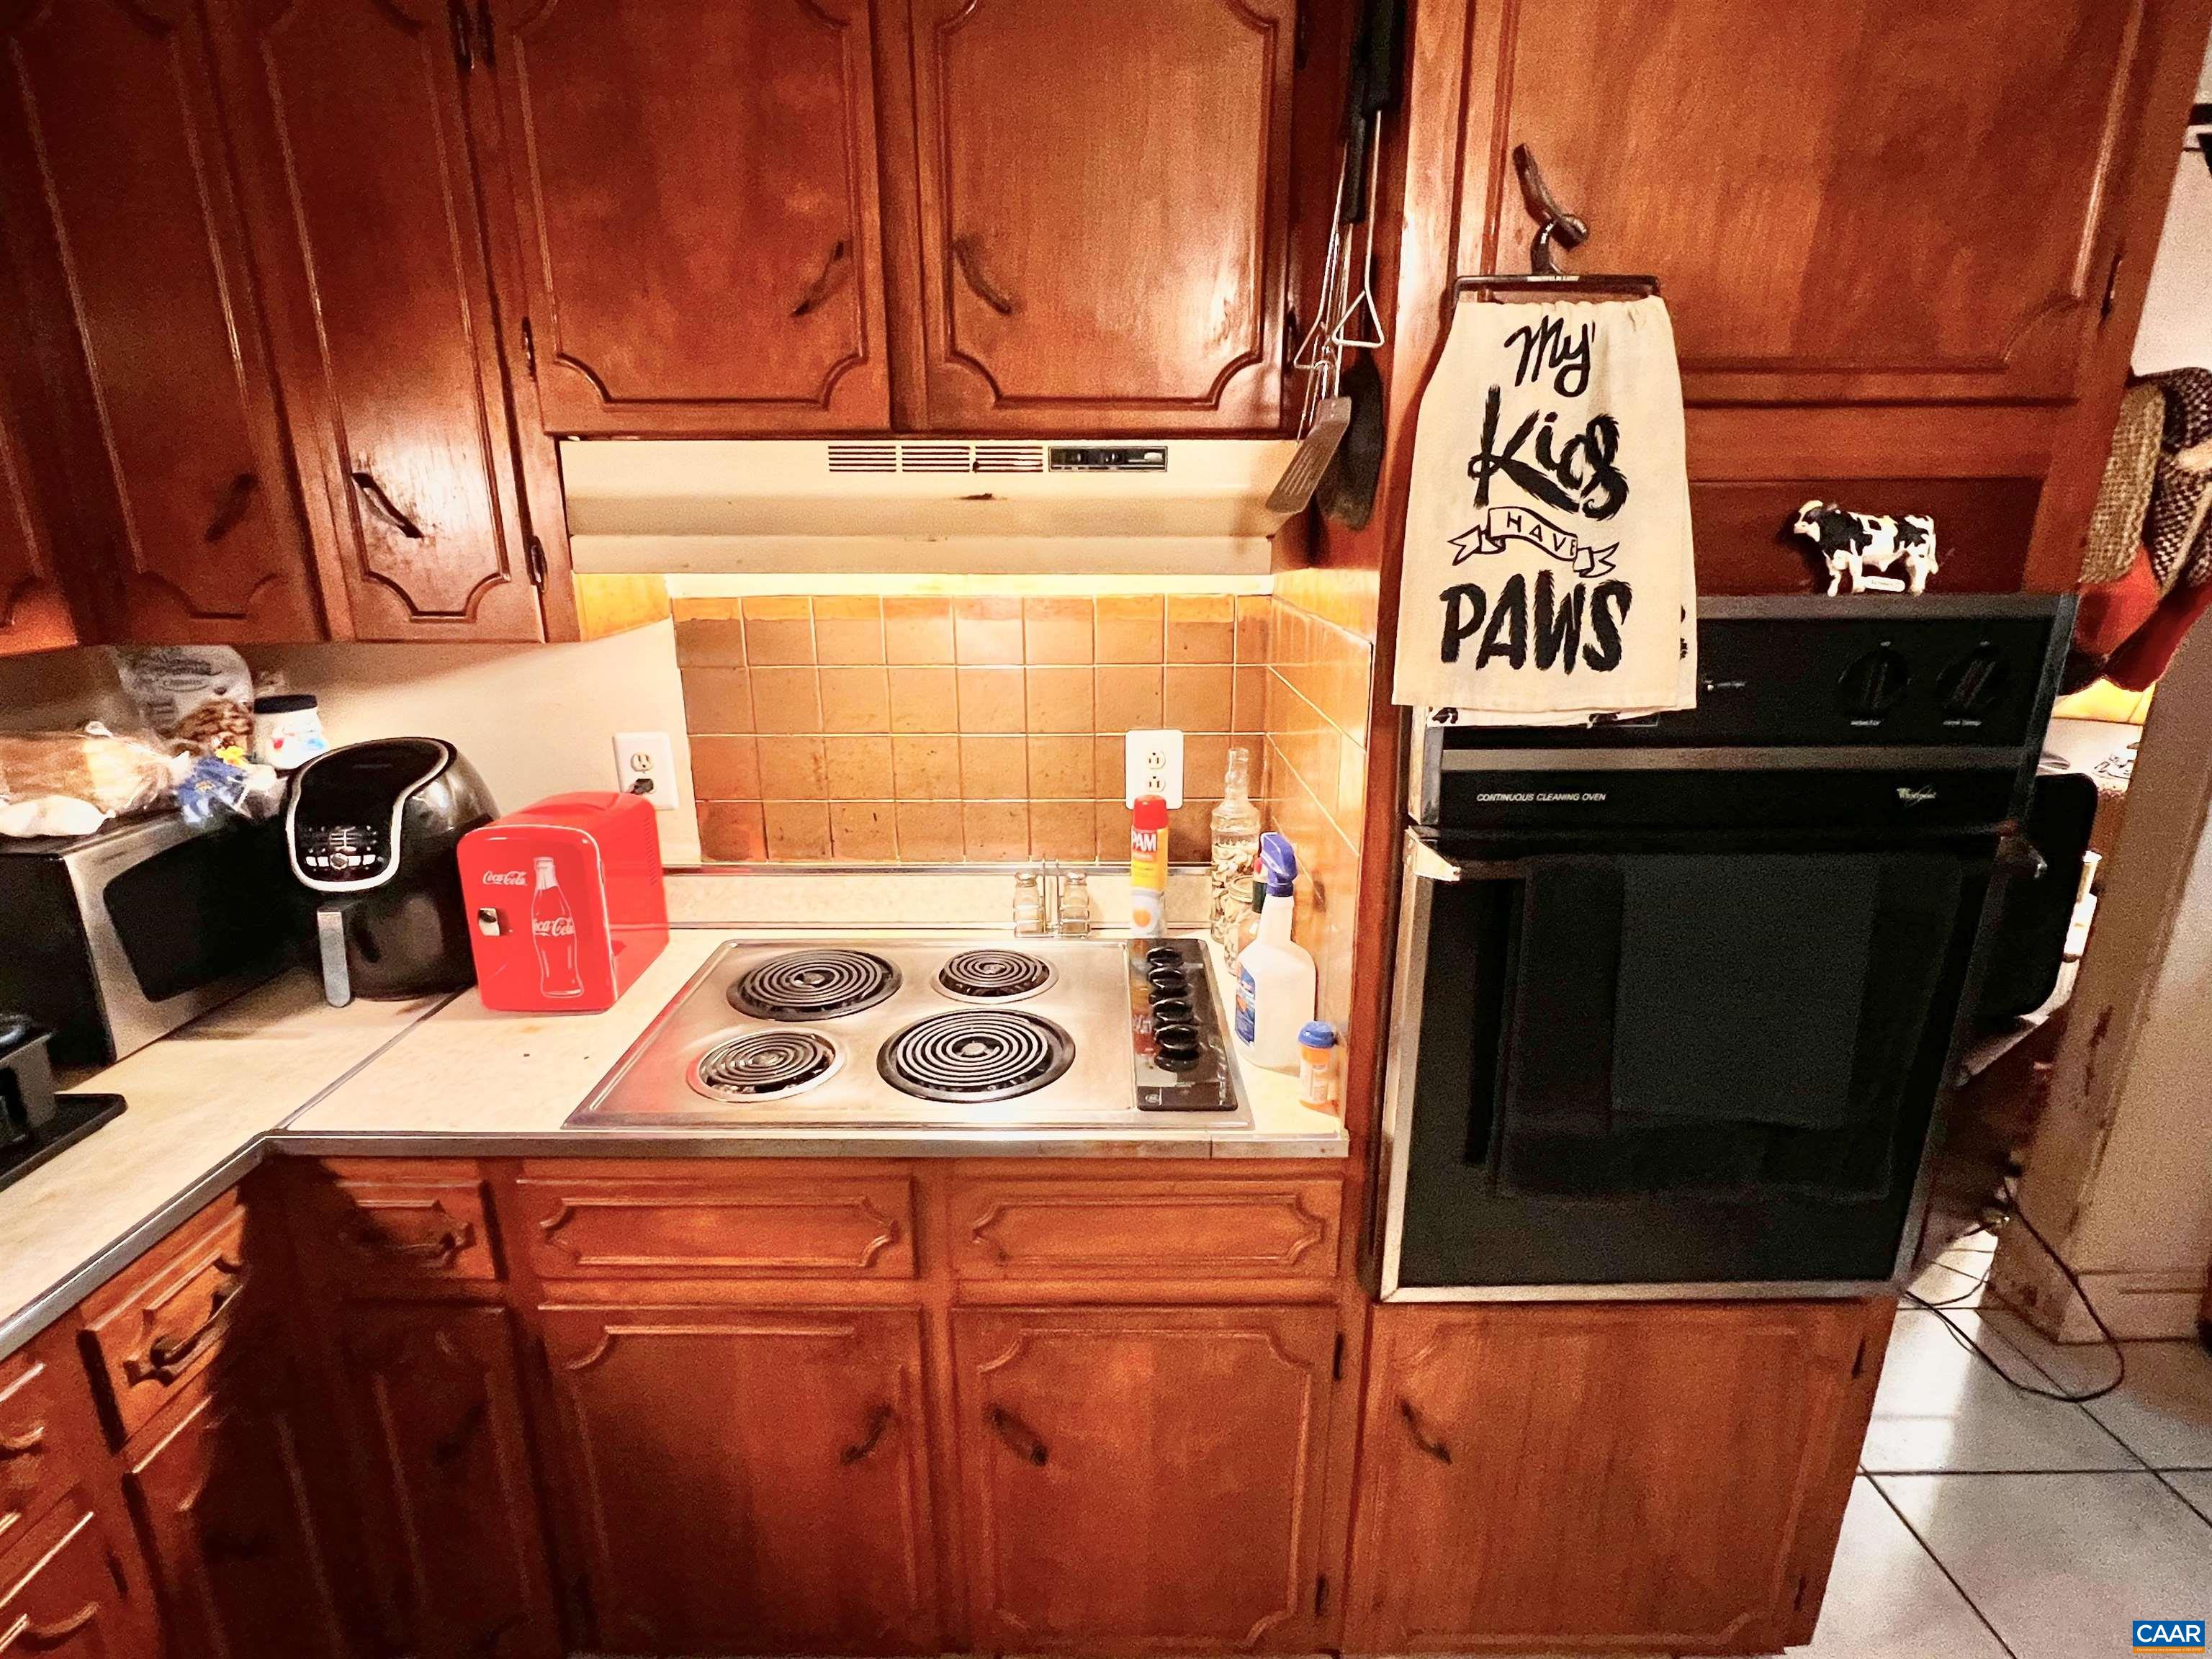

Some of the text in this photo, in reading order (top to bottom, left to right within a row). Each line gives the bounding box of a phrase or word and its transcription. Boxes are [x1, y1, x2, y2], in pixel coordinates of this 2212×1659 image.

[1503, 315, 1596, 397] My
[1468, 385, 1629, 521] Kids
[1506, 511, 1578, 557] HAVE
[1439, 569, 1632, 675] PAWS
[1476, 793, 1606, 801] CONTINUOUS CLEANING OVEN
[1131, 830, 1156, 853] PAM
[482, 870, 527, 886] Coca-Cola
